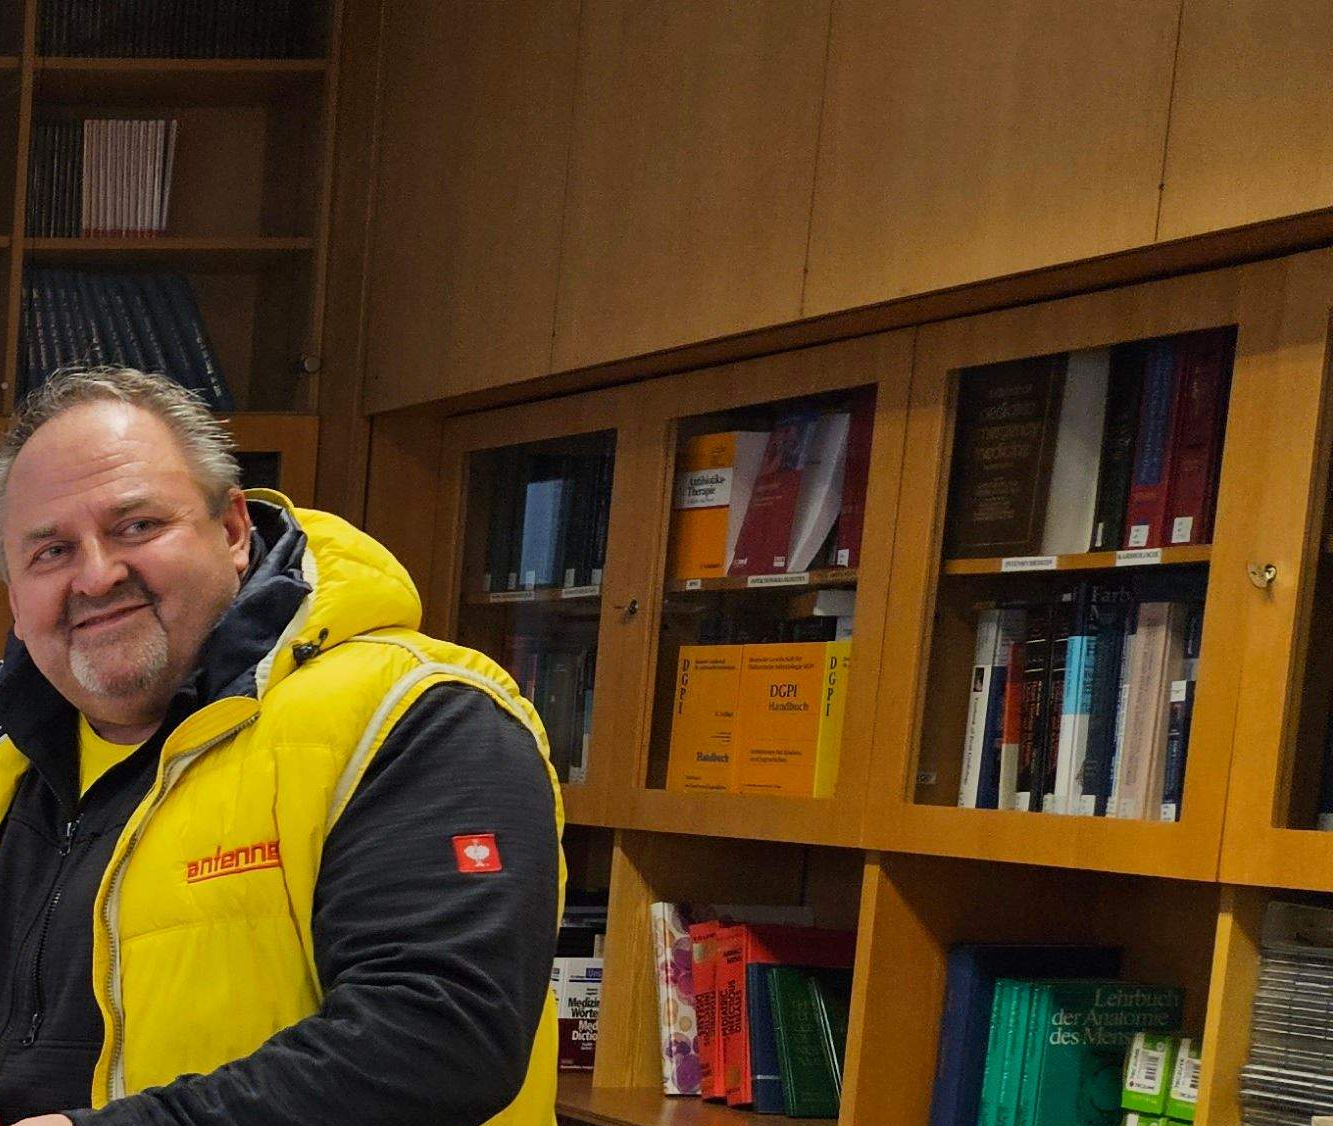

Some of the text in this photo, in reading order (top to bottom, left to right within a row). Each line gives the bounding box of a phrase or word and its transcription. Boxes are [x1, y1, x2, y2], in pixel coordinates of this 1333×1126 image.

[770, 683, 797, 698] DGPI
[186, 839, 281, 878] antenne
[1093, 988, 1179, 1007] Lehrbuch
[1051, 1009, 1080, 1026] der
[1049, 1028, 1079, 1046] des
